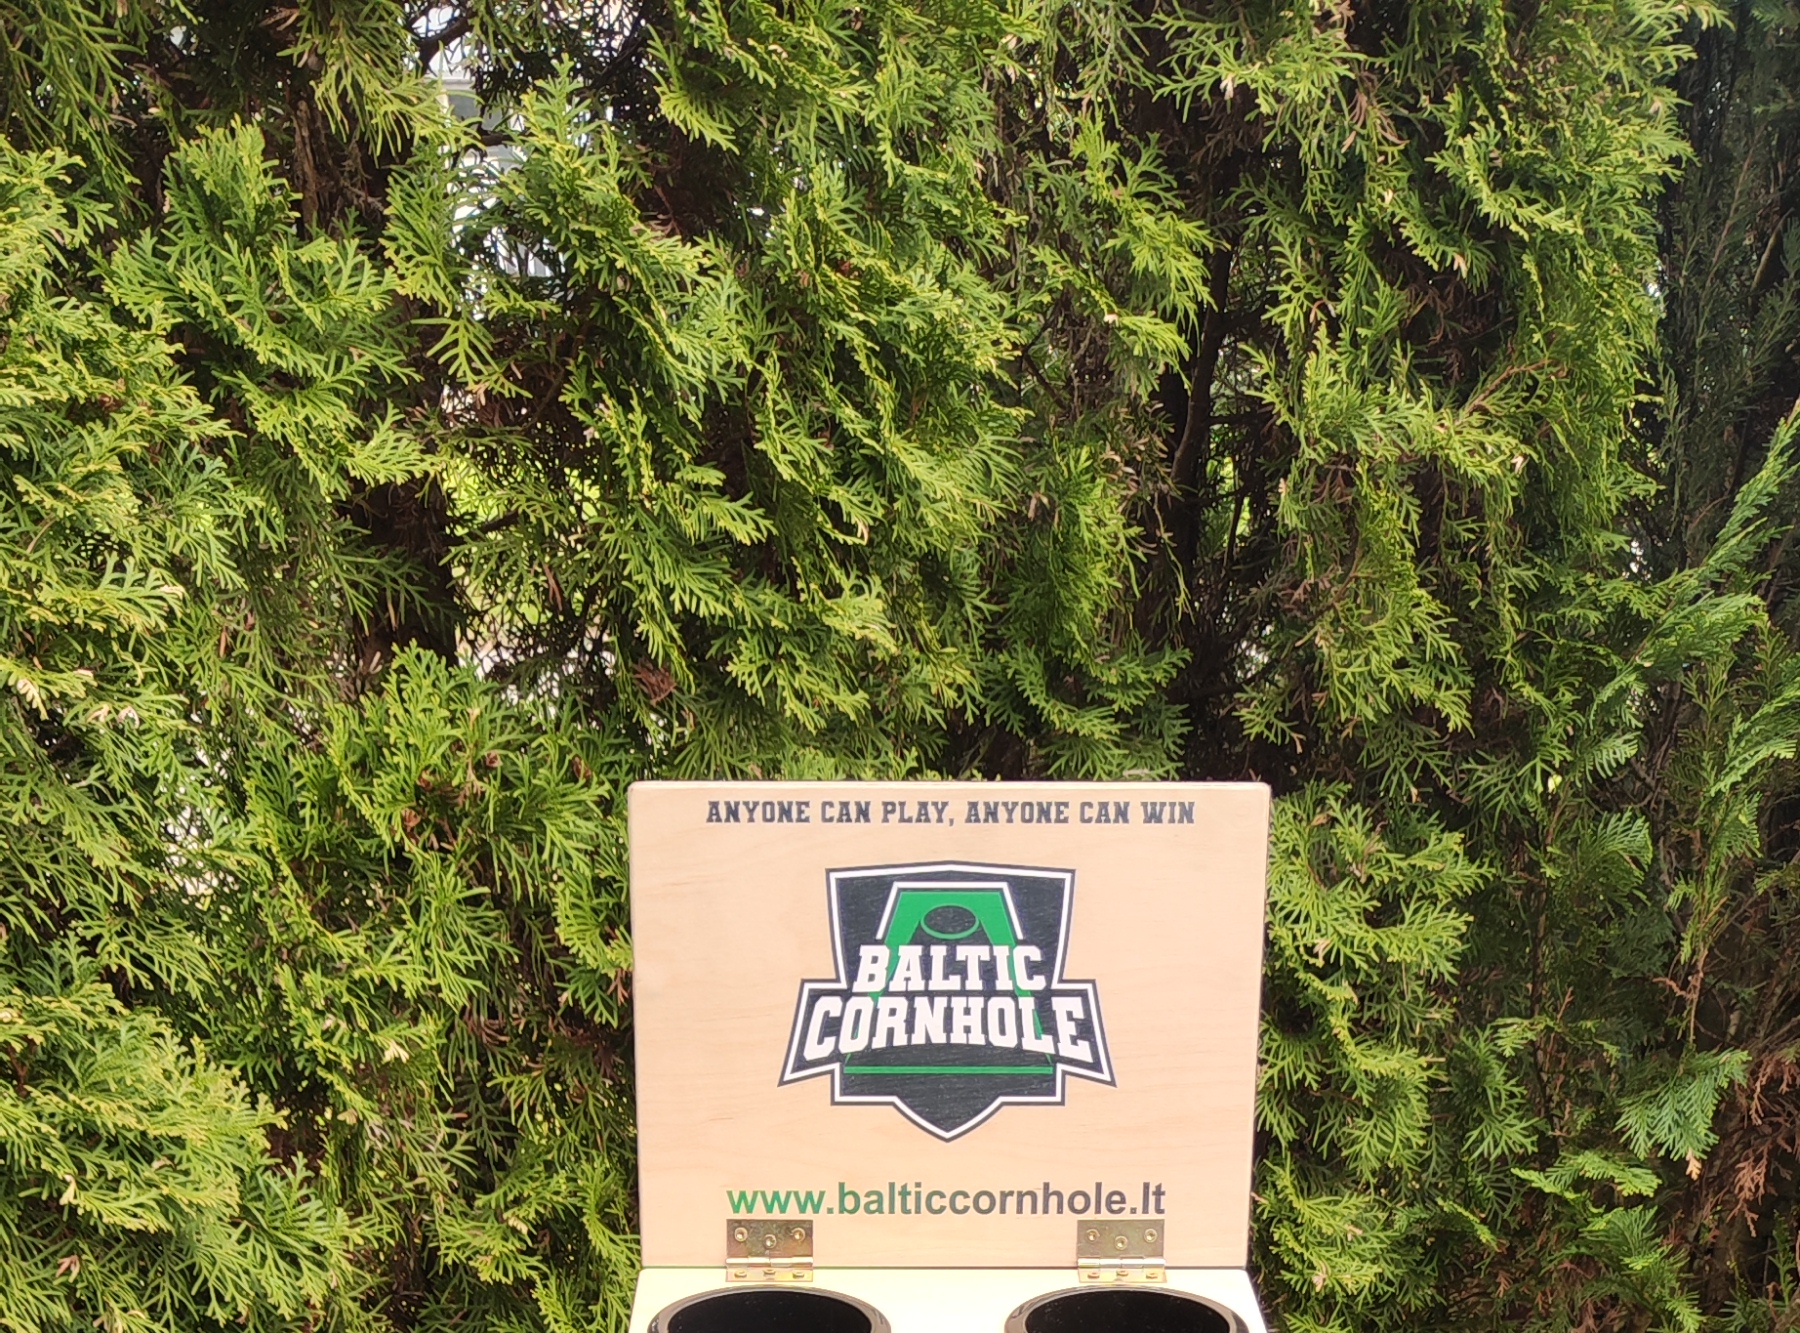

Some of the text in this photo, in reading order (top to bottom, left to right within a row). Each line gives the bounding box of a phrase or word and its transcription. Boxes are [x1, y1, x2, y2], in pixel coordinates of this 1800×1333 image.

[706, 800, 1195, 827] ANYONE CAN PLAY, ANYONE CAN WIN
[852, 944, 1047, 993] BALTIC
[802, 996, 1094, 1063] CORNHOLE
[727, 1182, 1165, 1216] www.balticcornhole.lt
